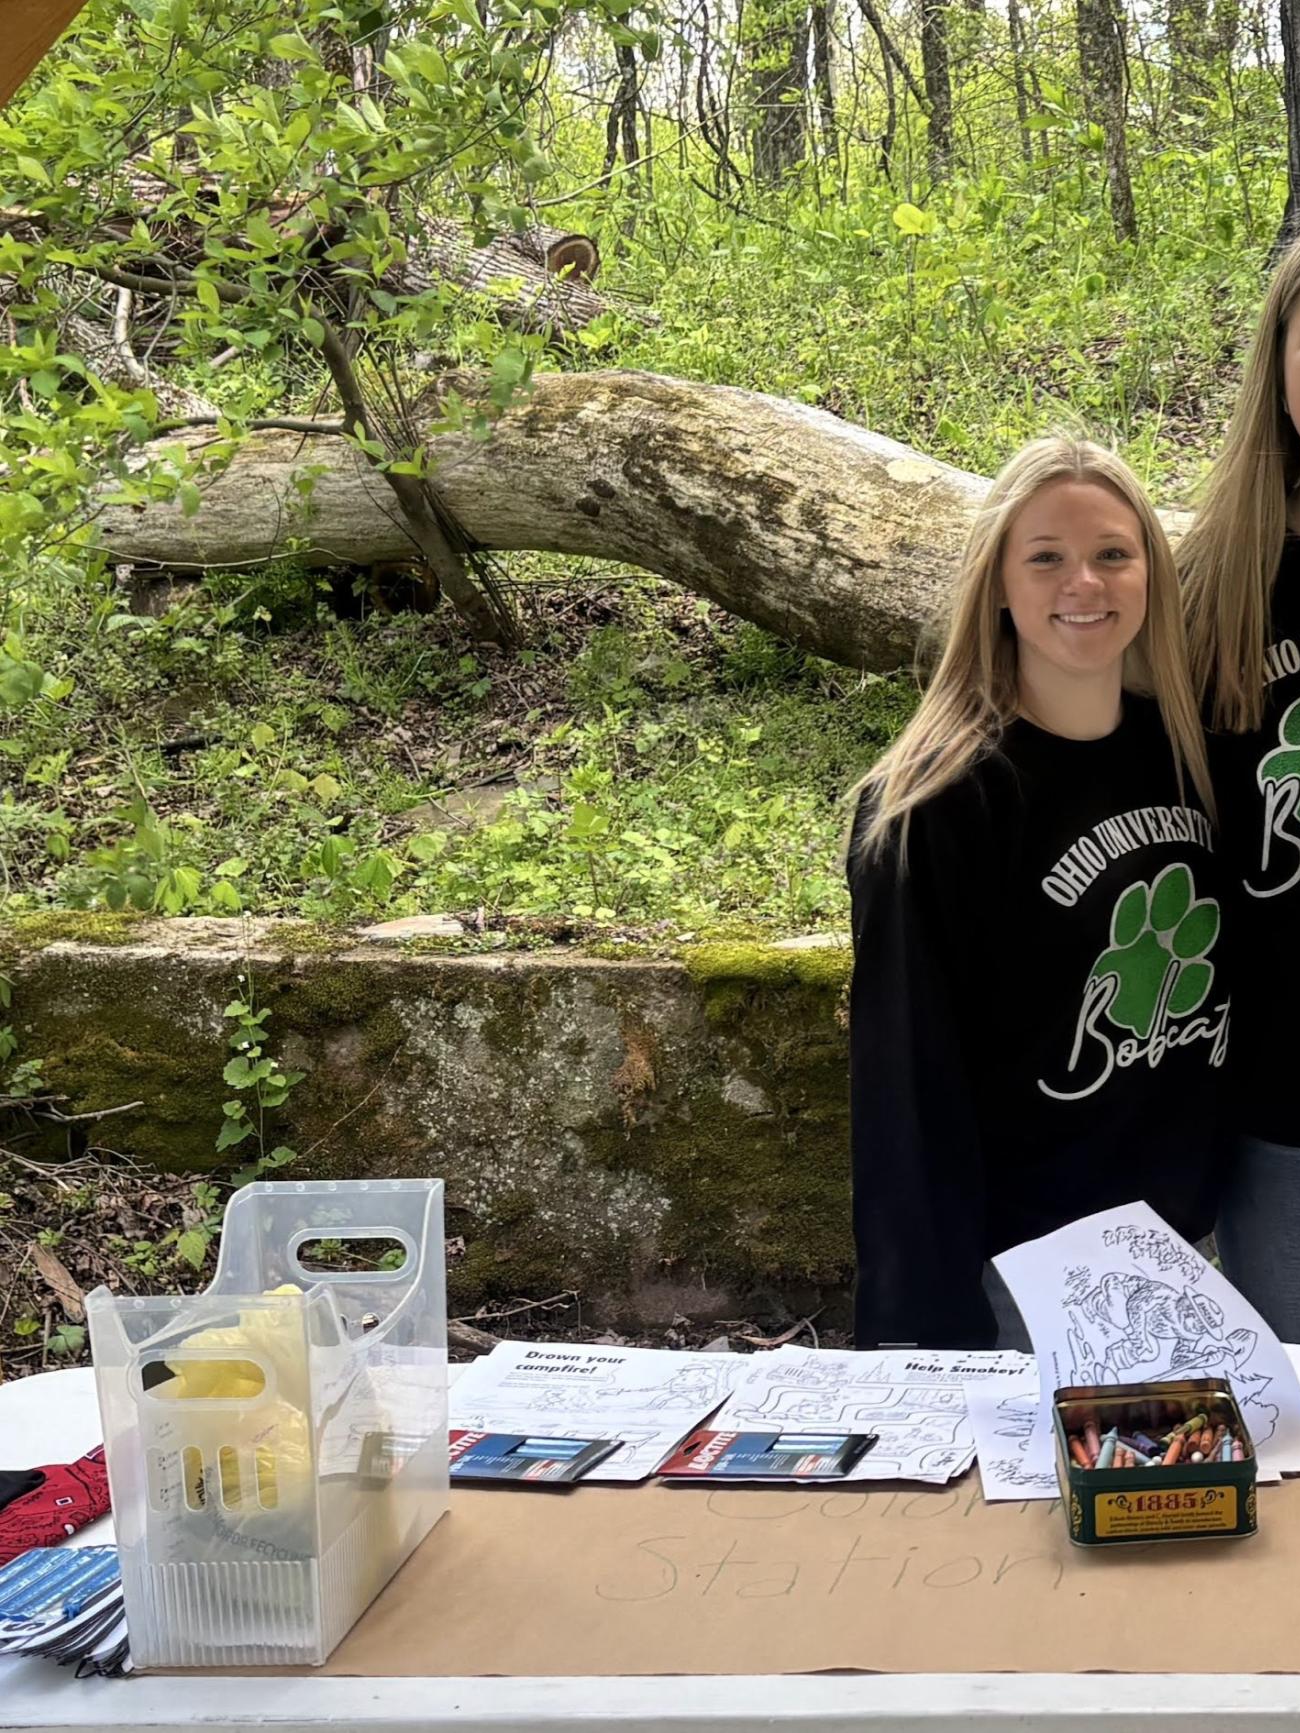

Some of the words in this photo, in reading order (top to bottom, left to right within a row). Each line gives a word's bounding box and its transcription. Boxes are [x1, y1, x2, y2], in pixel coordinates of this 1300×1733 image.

[1262, 639, 1300, 686] HIO
[1041, 836, 1107, 907] OHIO
[524, 1350, 581, 1363] Drown
[587, 1354, 626, 1365] your
[515, 1362, 598, 1375] campfire!
[904, 1361, 945, 1373] Help
[949, 1365, 1026, 1376] Smokey!
[1136, 1491, 1198, 1512] 1885
[595, 1534, 1064, 1602] Station
